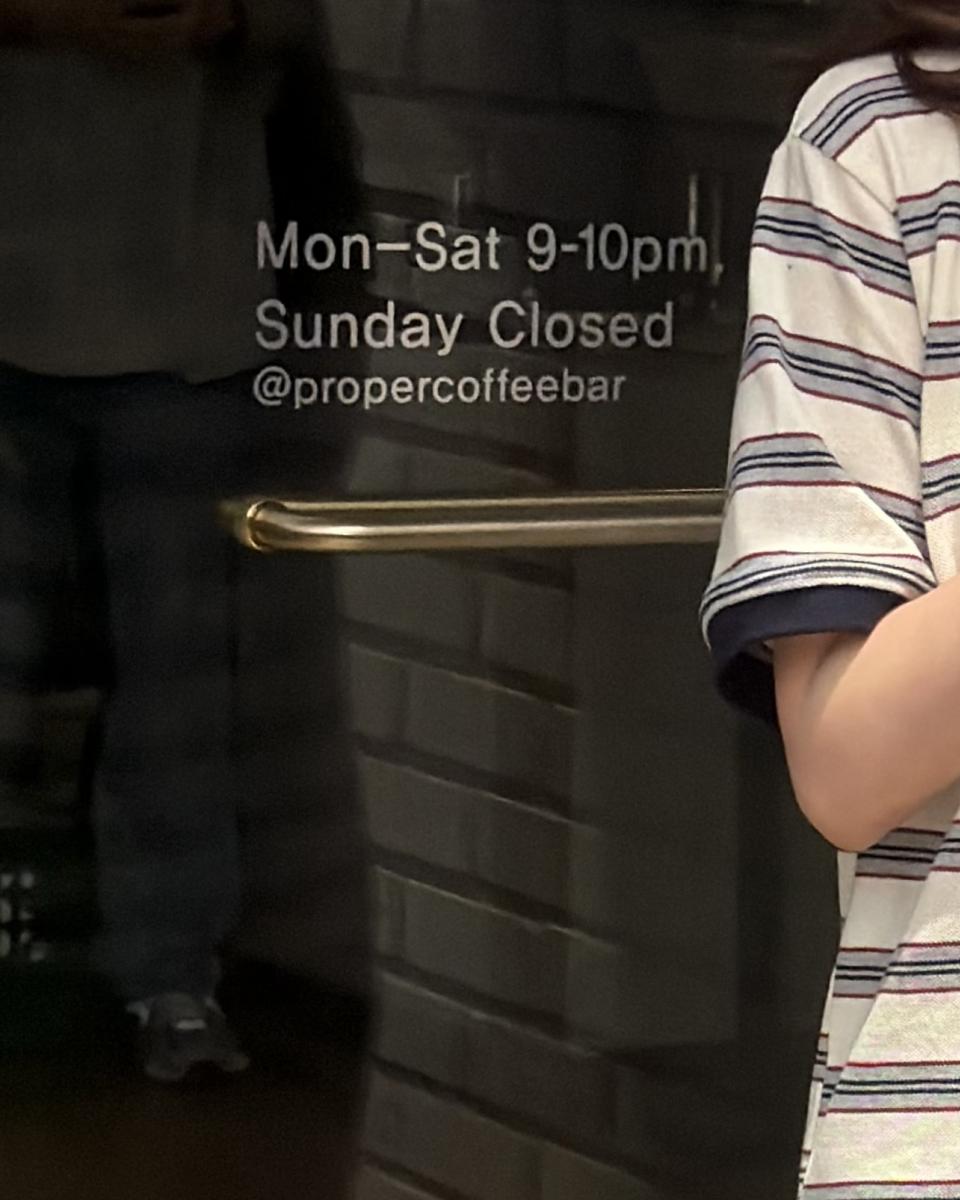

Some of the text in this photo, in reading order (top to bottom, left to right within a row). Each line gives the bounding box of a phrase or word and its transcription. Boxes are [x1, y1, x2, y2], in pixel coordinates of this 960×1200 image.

[255, 299, 674, 356] Sunday Closed
[253, 365, 627, 409] @propercoffeebar
